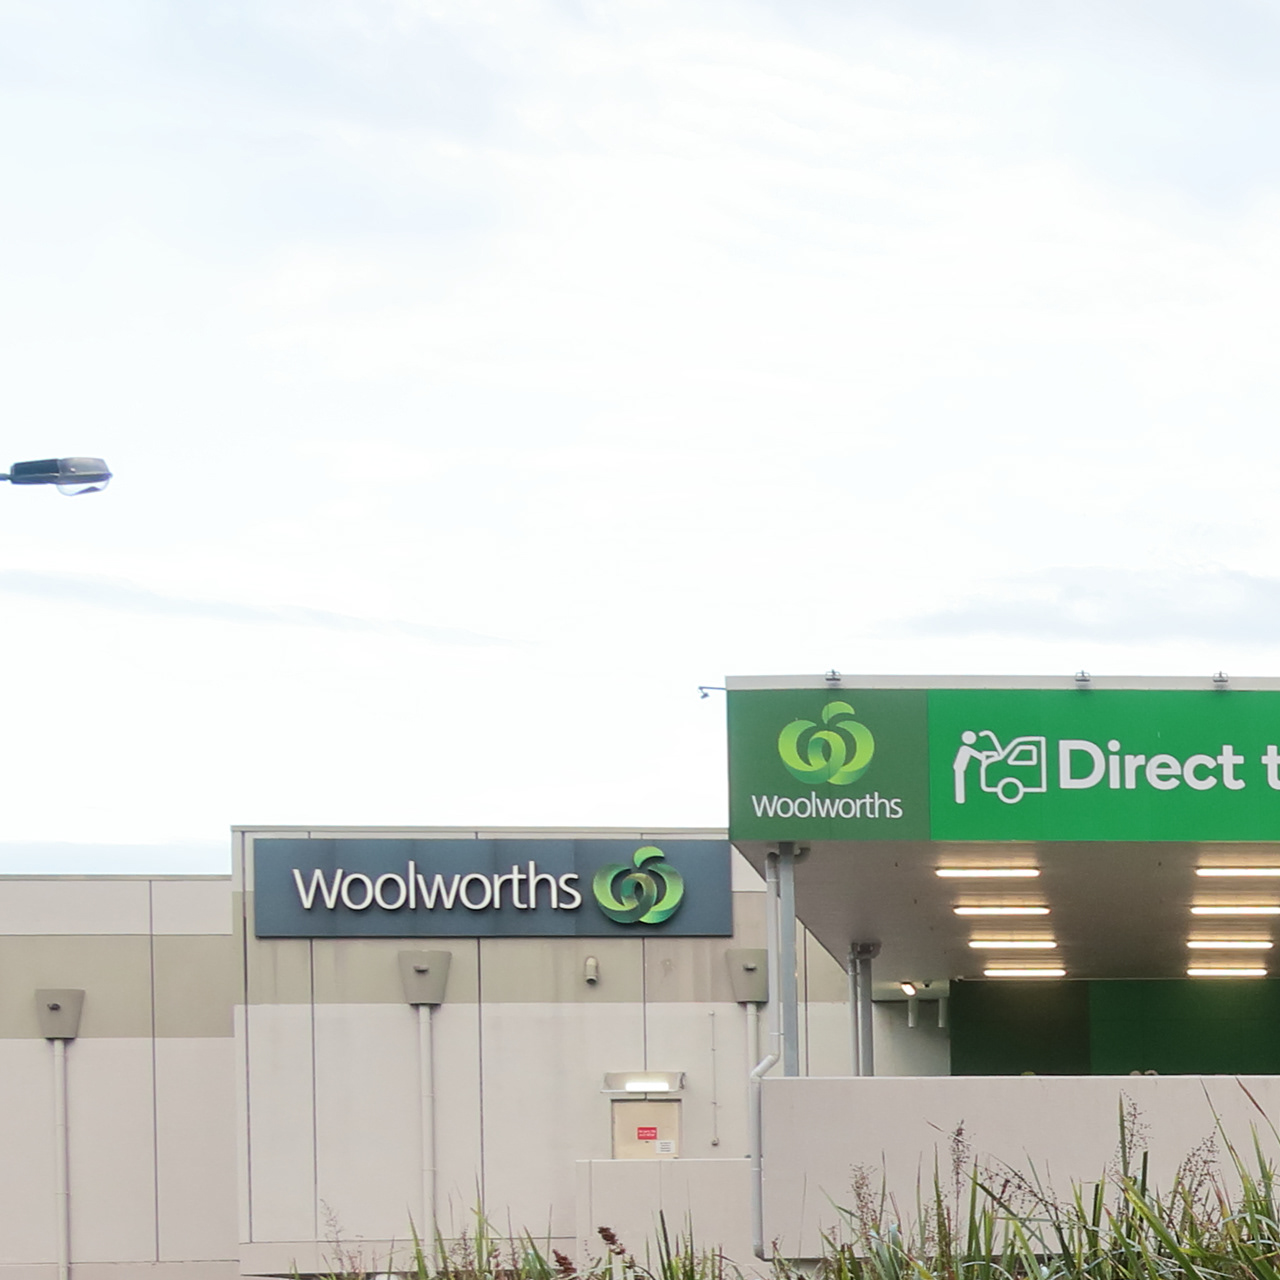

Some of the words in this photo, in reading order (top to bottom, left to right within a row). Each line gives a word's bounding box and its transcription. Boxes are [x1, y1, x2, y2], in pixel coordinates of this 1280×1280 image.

[1058, 739, 1246, 791] Direct
[751, 791, 904, 819] Woolworths
[292, 860, 583, 910] Woolworths
